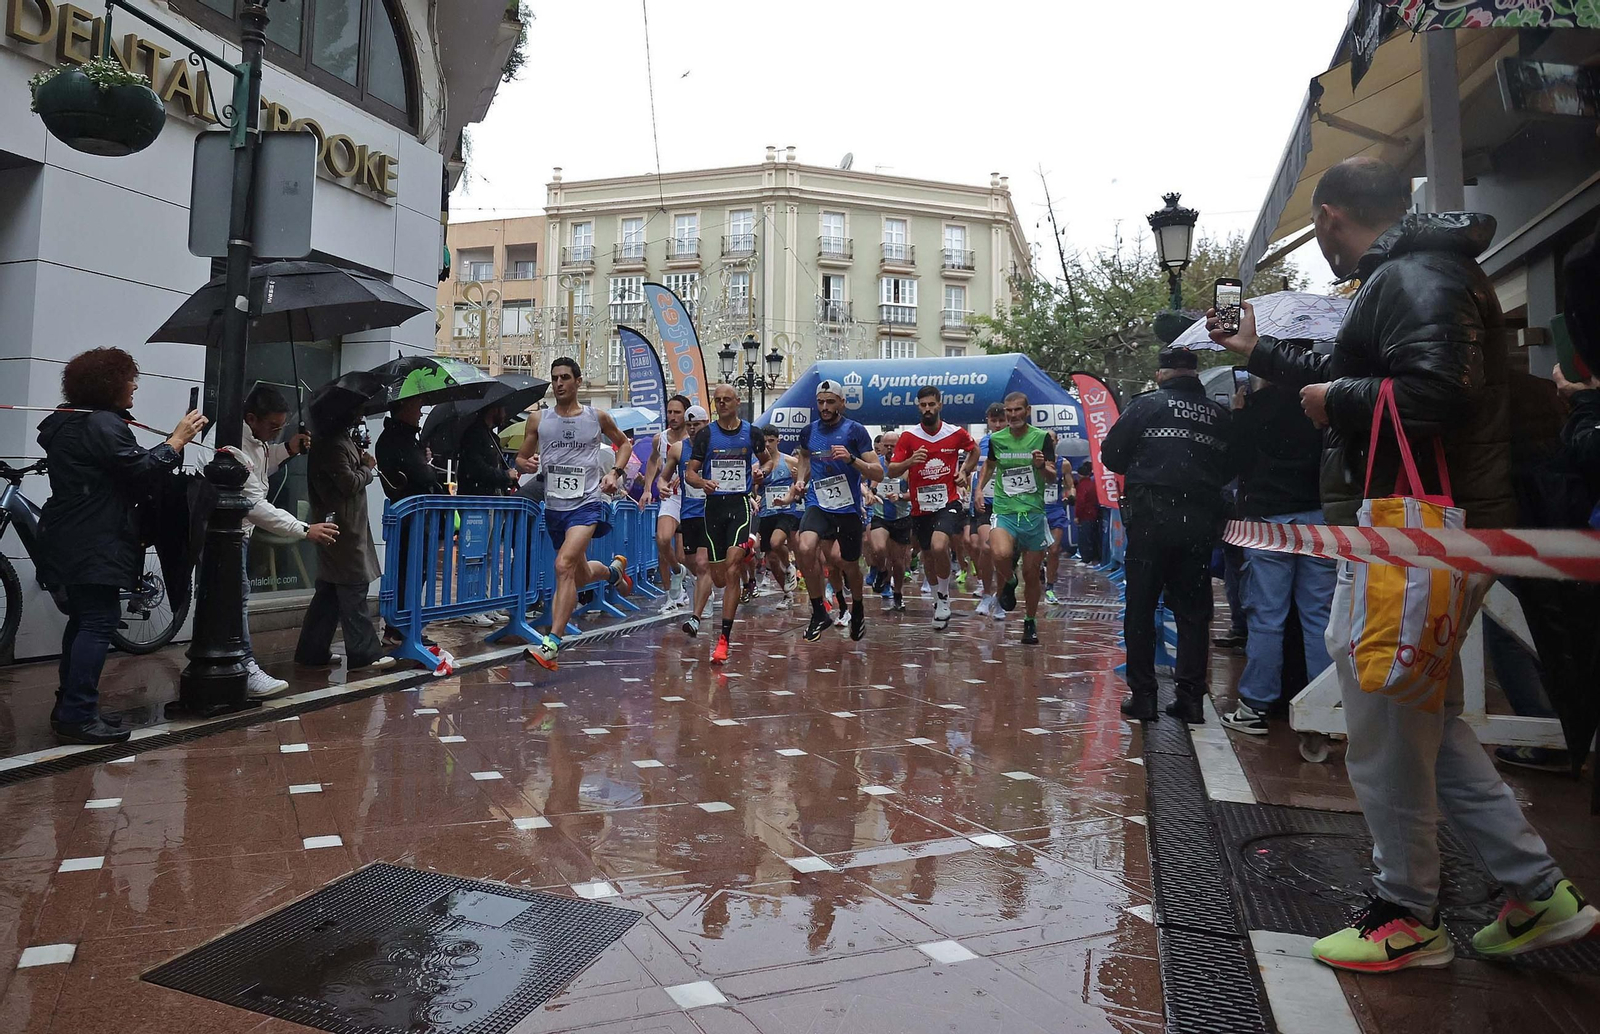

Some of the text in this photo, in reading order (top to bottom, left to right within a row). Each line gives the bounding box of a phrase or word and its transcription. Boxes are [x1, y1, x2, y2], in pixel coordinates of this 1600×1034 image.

[5, 0, 398, 198] DENTAL ROOKE
[868, 371, 988, 391] Ayuntamiento
[881, 392, 902, 406] de
[939, 390, 976, 405] ínea
[1168, 399, 1218, 418] POLICIA
[775, 412, 785, 423] D
[1036, 410, 1048, 422] D
[1174, 408, 1213, 425] LOCAL
[778, 434, 800, 442] PORT
[551, 440, 587, 449] Gibraltar
[720, 470, 741, 480] 225
[556, 477, 578, 490] 153
[1010, 475, 1031, 488] 324
[827, 486, 842, 498] 23
[925, 493, 944, 503] 282
